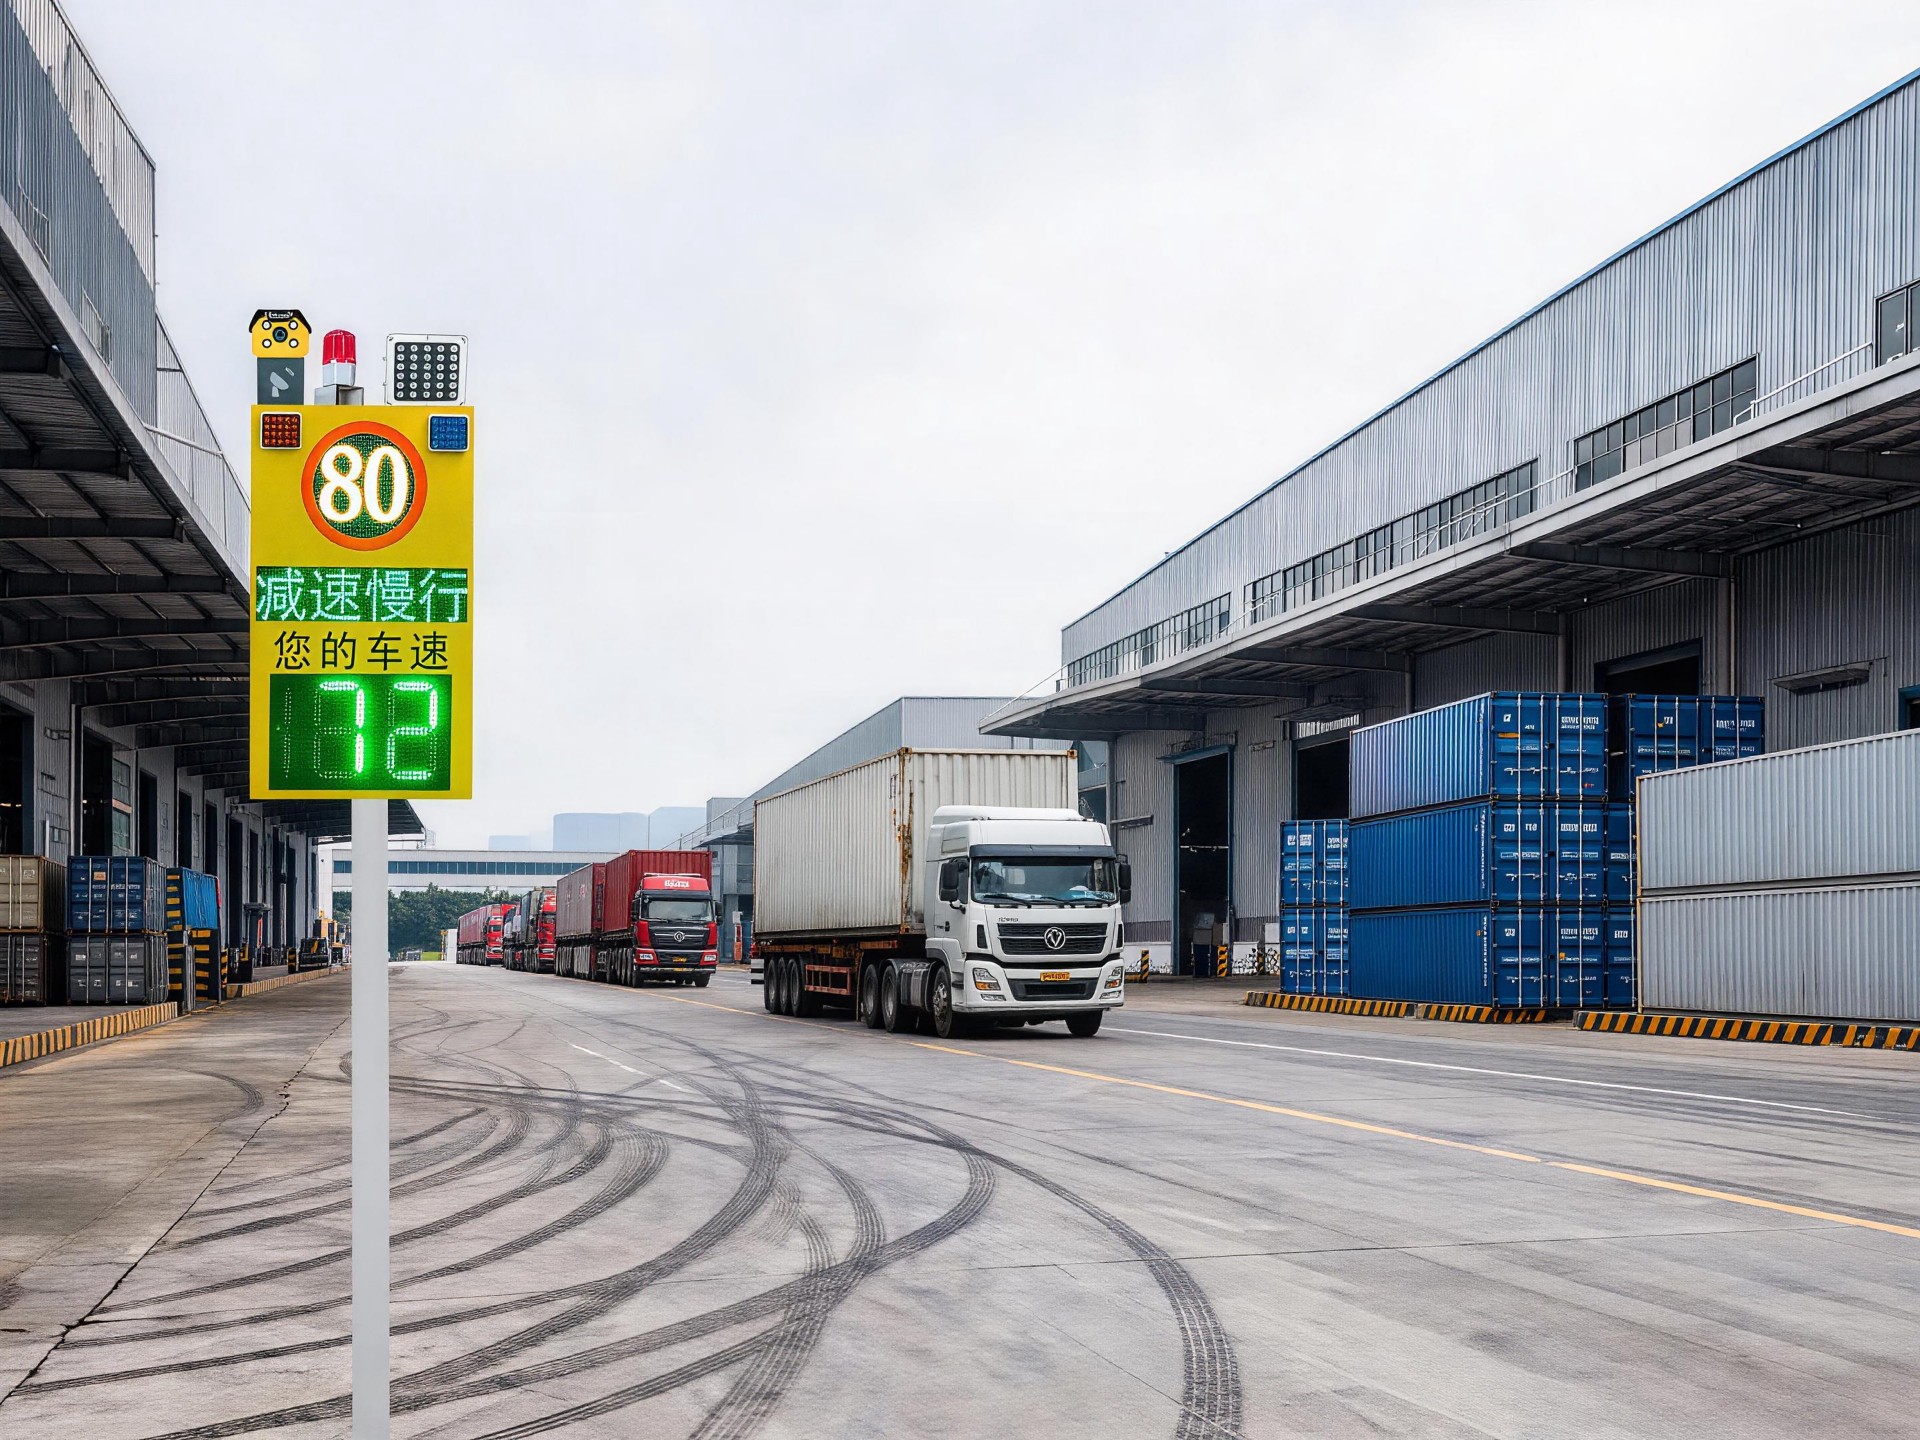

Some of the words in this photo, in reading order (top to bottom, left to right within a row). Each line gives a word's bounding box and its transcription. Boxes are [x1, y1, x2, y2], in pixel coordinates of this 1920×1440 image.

[319, 444, 409, 524] 80
[256, 567, 468, 622] 减速慢行
[274, 630, 449, 671] 您的车速
[318, 680, 439, 780] 72
